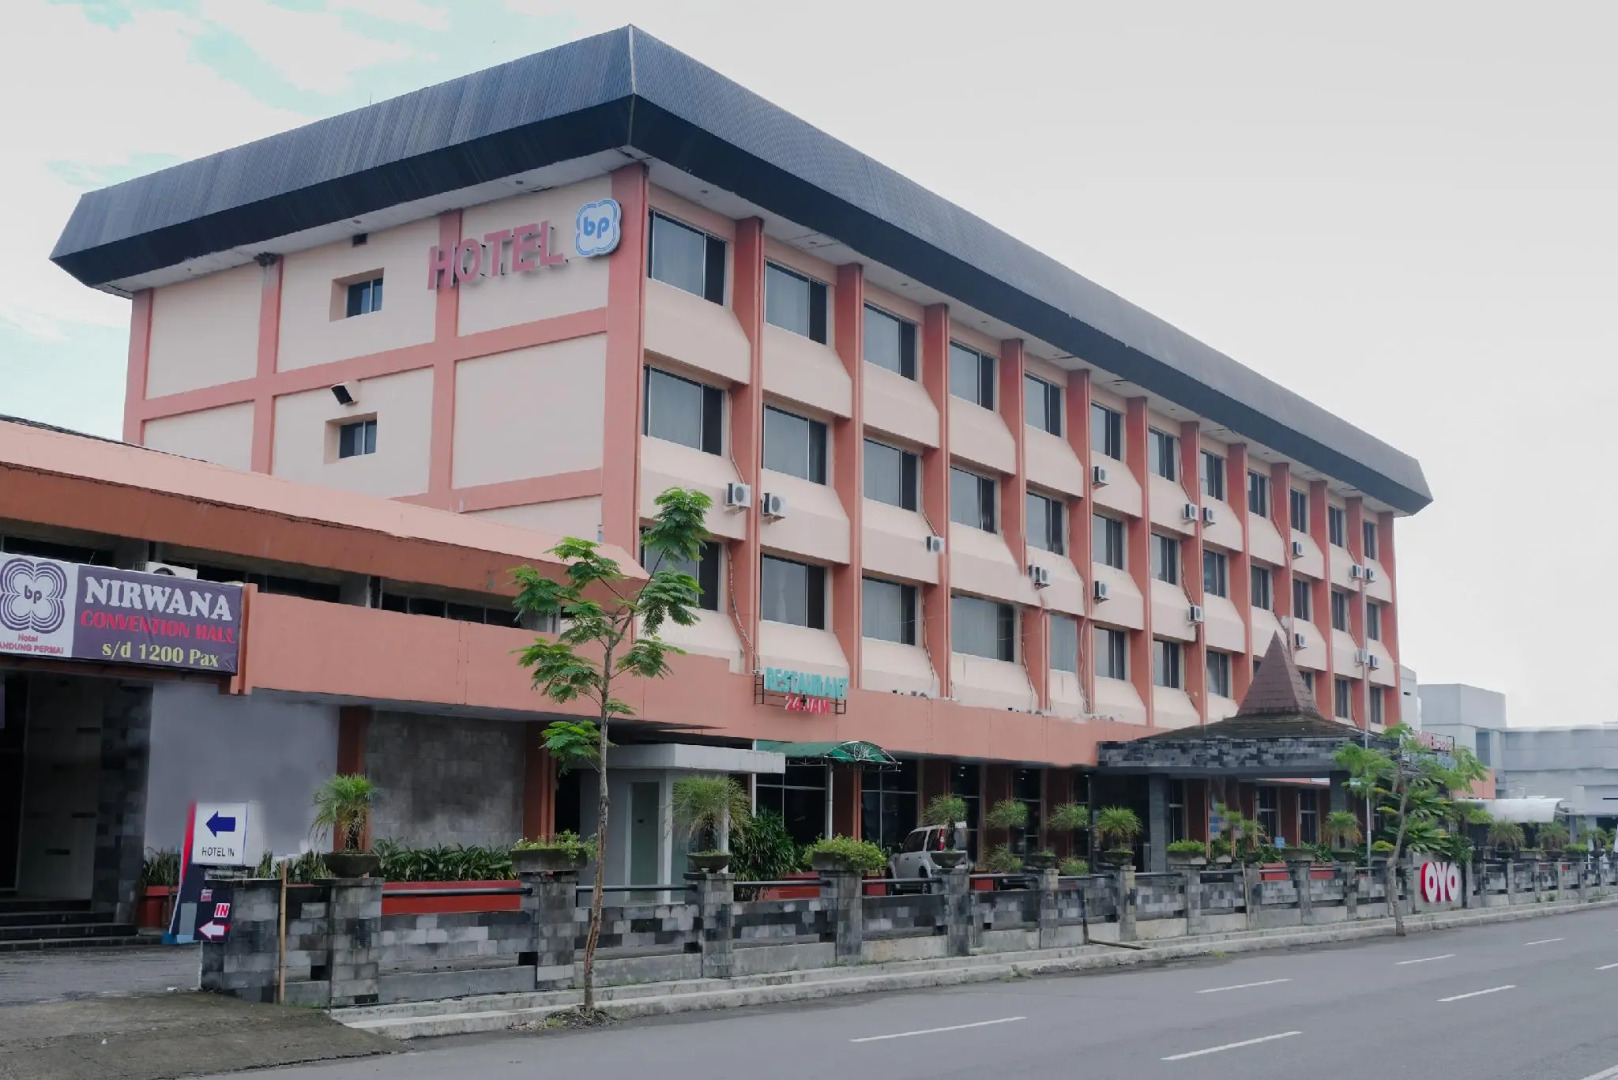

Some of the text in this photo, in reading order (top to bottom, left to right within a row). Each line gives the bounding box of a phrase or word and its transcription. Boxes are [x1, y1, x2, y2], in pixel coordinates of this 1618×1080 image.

[583, 216, 610, 238] bp
[428, 220, 564, 290] HOTEL
[24, 585, 42, 604] bp
[84, 576, 232, 621] NIRWANA
[18, 633, 38, 642] Hotel
[81, 609, 235, 644] CONVENTION HALL
[0, 641, 64, 654] ANDUNG PERMAI
[102, 641, 219, 668] s/d 1200 Pax
[765, 667, 849, 699] RESTAURANT
[785, 694, 830, 714] 24 JAM
[202, 847, 235, 857] HOTEL IN
[1421, 861, 1458, 903] OYO
[214, 903, 230, 917] IN
